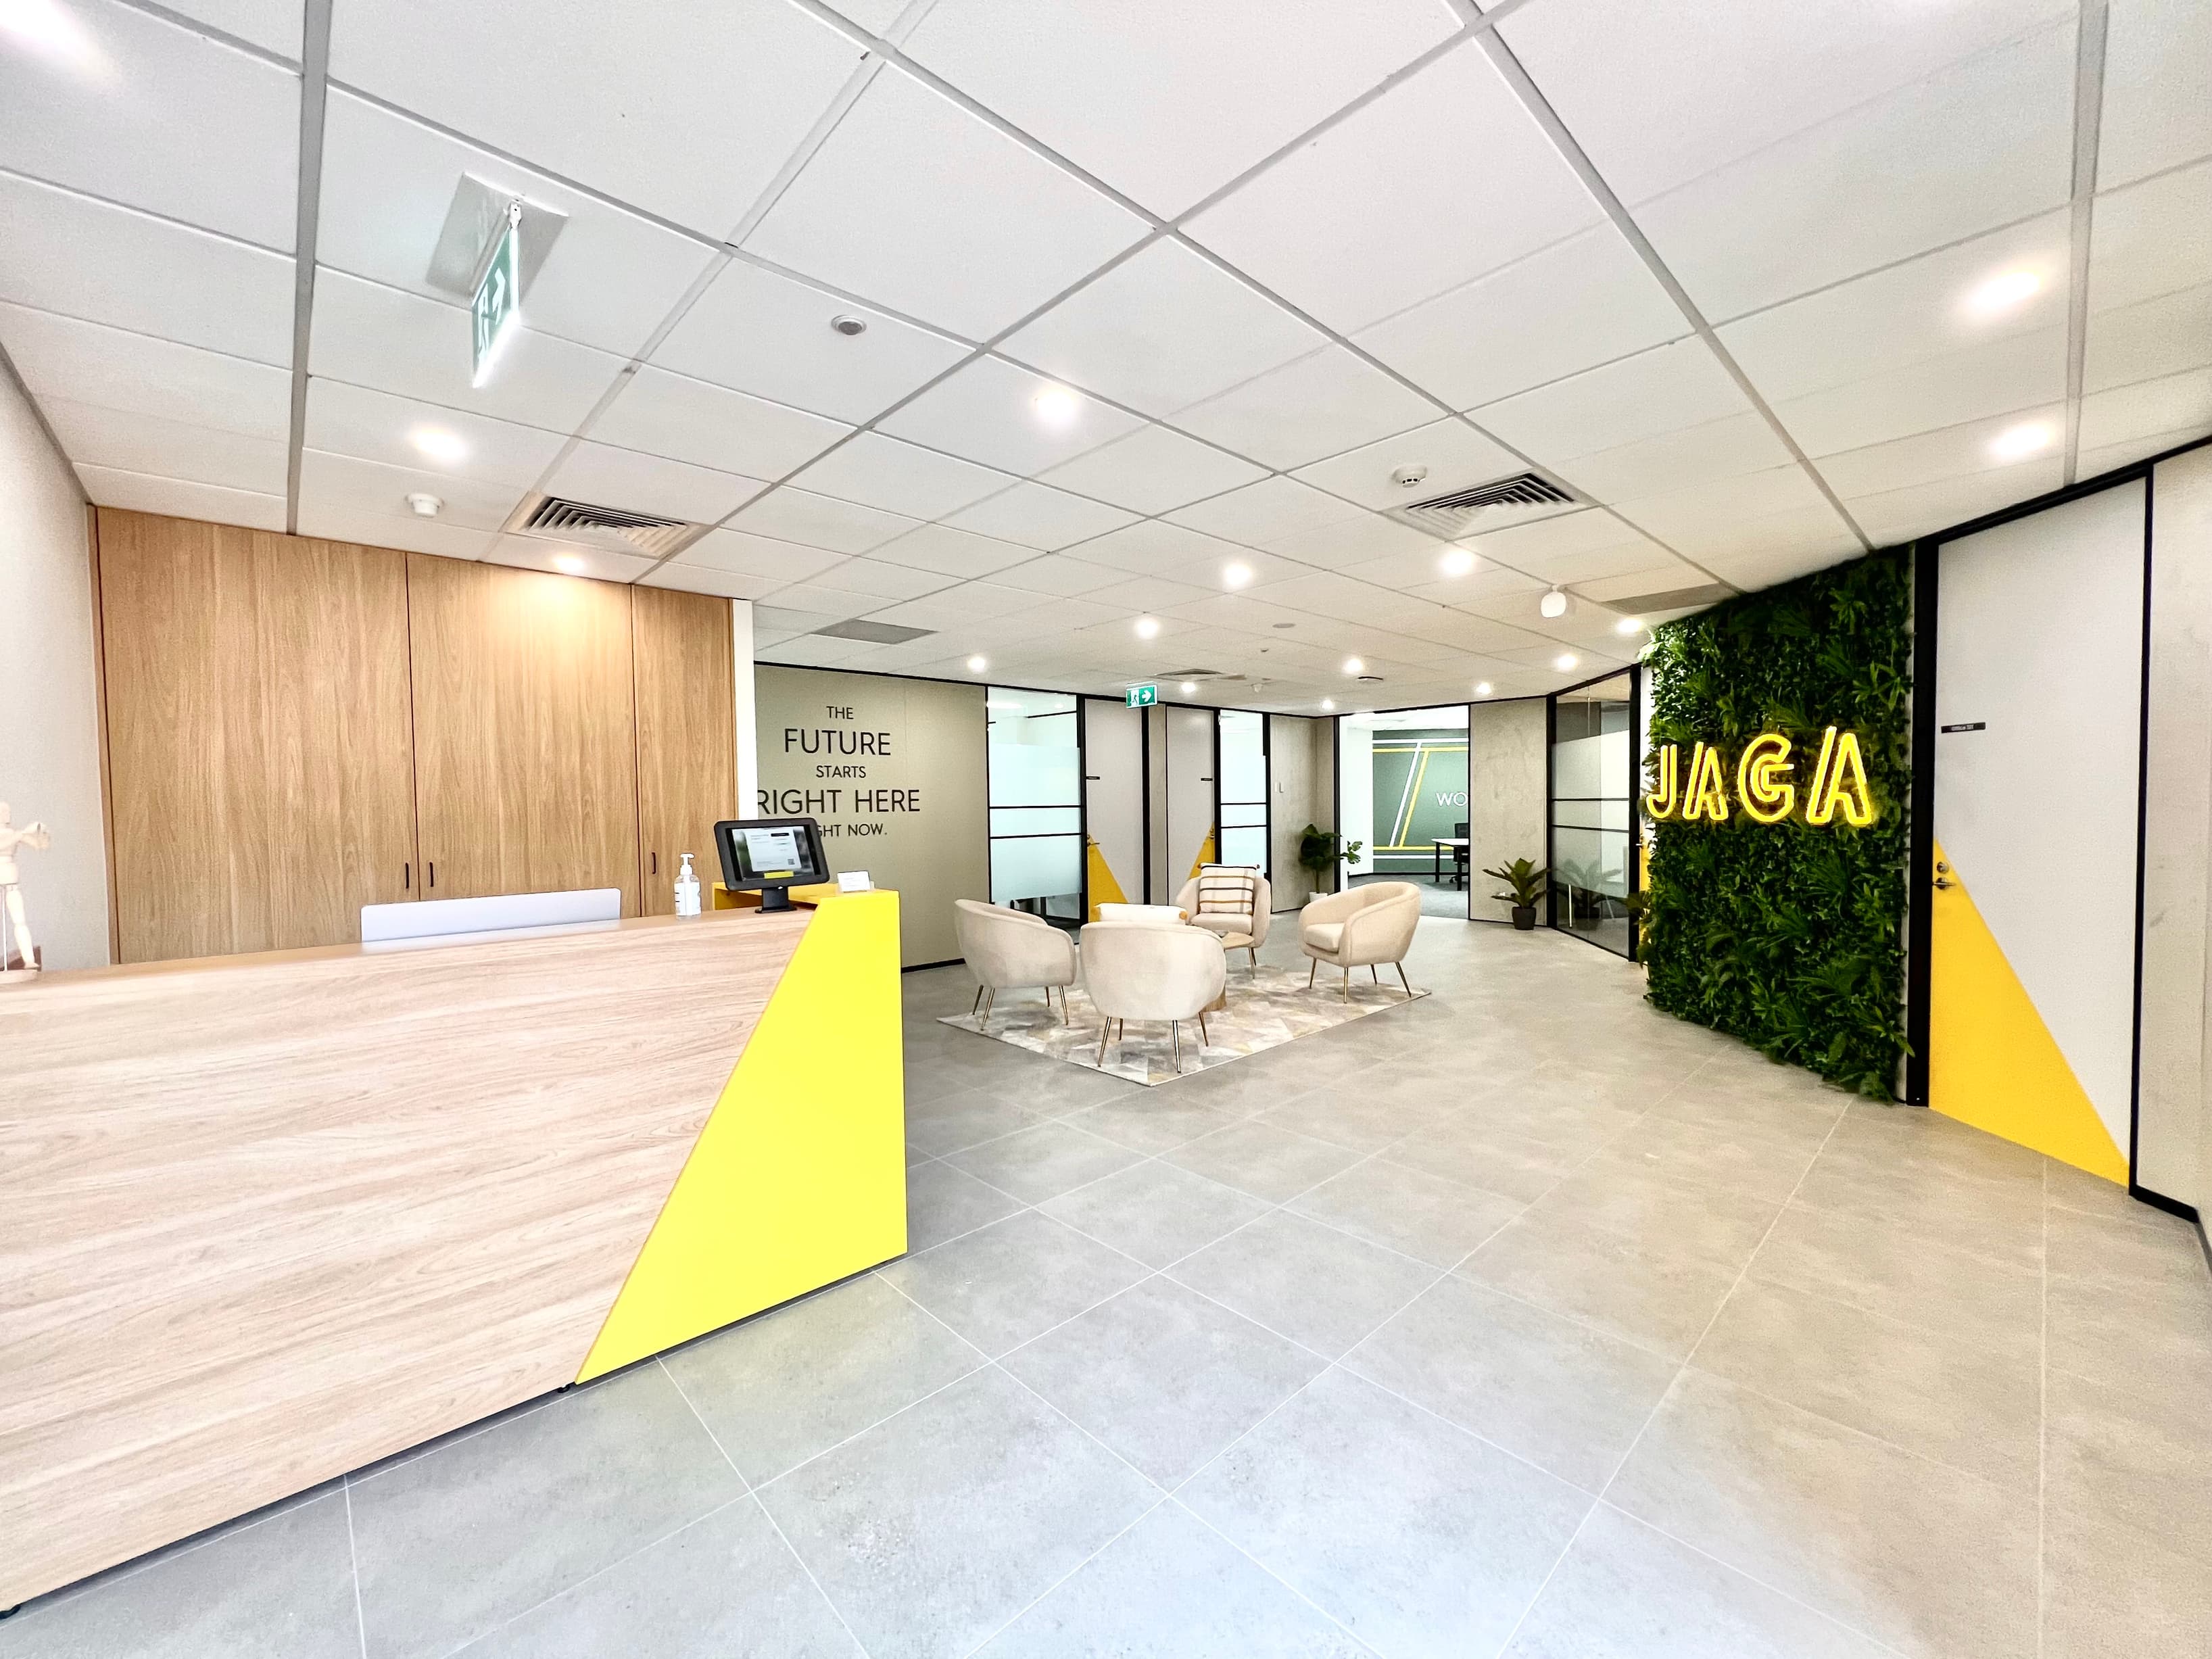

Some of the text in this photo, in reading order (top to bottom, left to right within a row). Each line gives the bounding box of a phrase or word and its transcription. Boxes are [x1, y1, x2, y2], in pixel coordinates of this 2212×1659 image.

[826, 706, 854, 720] THE
[785, 728, 891, 756] FUTURE
[816, 765, 866, 779] STARTS
[1645, 725, 1873, 825] JAGA
[757, 789, 920, 815] RIGHT HERE
[848, 823, 887, 836] NOW.
